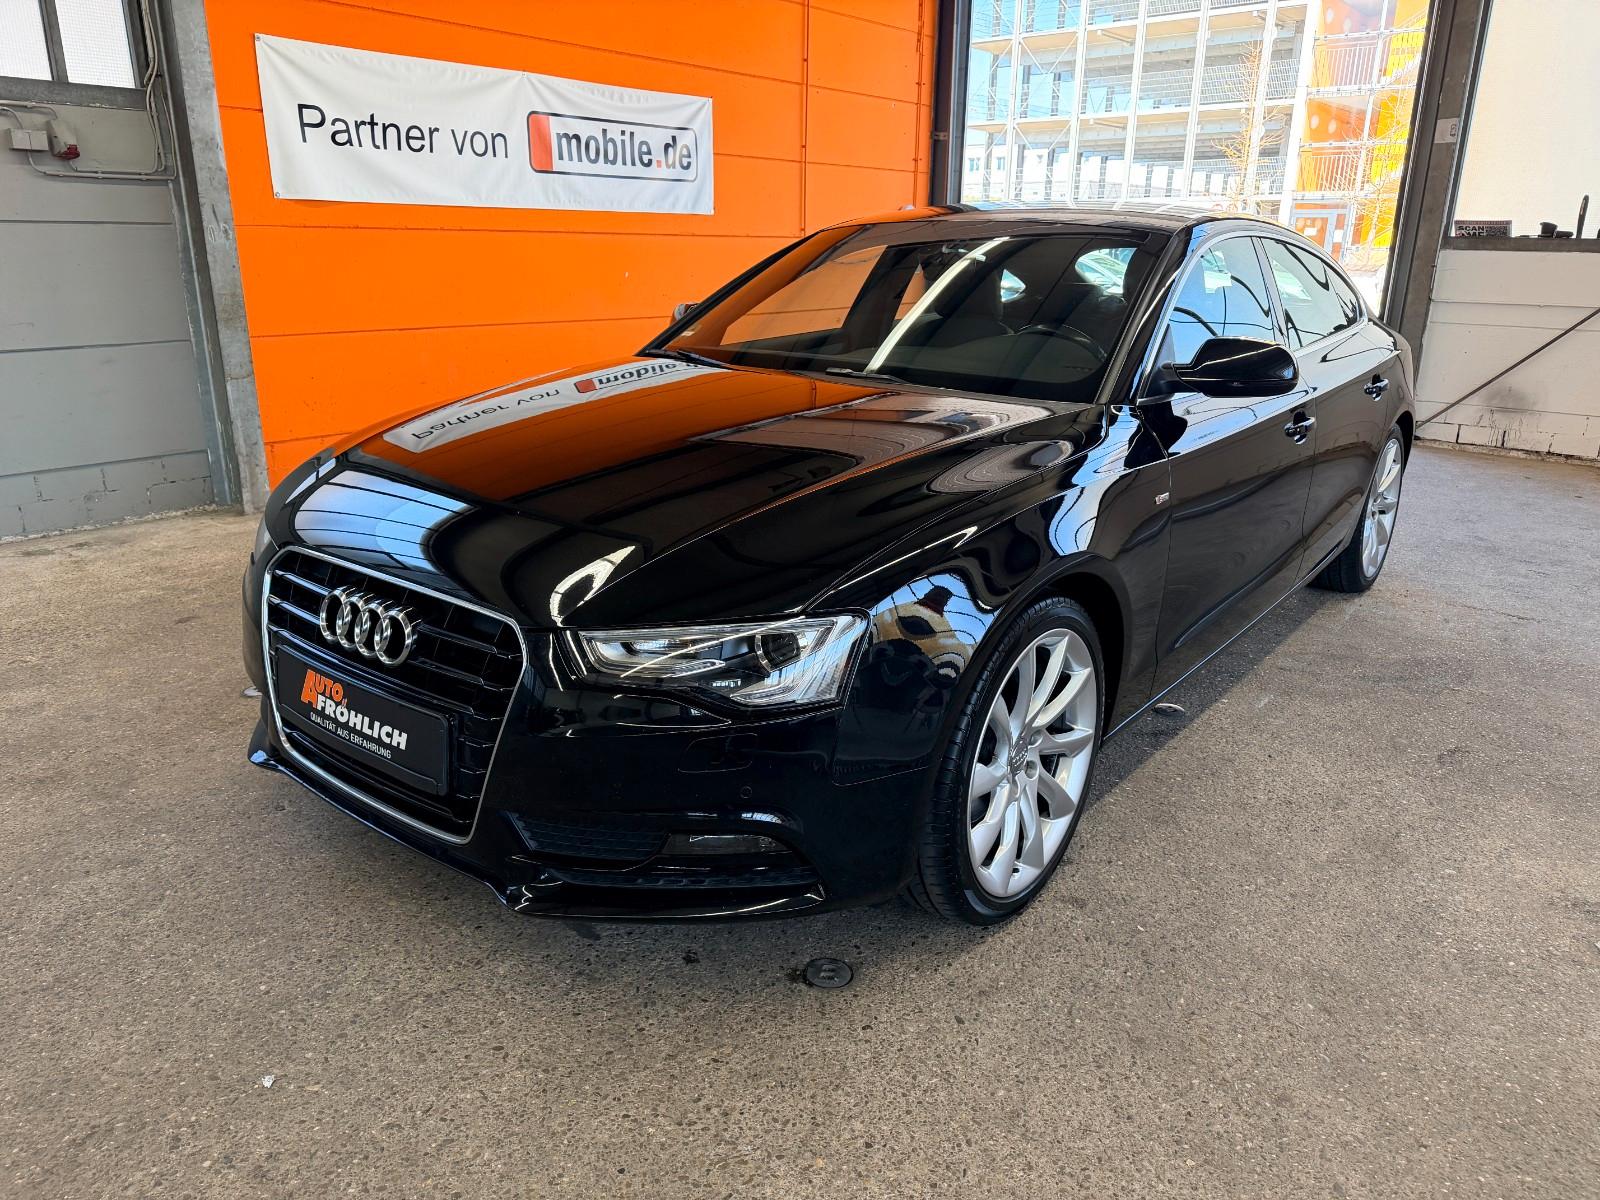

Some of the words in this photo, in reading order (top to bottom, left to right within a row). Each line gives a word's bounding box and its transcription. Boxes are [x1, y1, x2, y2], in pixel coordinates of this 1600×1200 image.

[297, 103, 440, 153] Partner
[450, 129, 508, 159] von
[556, 128, 692, 170] mobile.de
[301, 669, 343, 708] AUTO
[310, 711, 337, 733] QUALITÄT
[336, 726, 350, 740] AUS
[350, 733, 392, 759] ERFAHRUNG
[317, 694, 407, 750] FRÖHLICH
